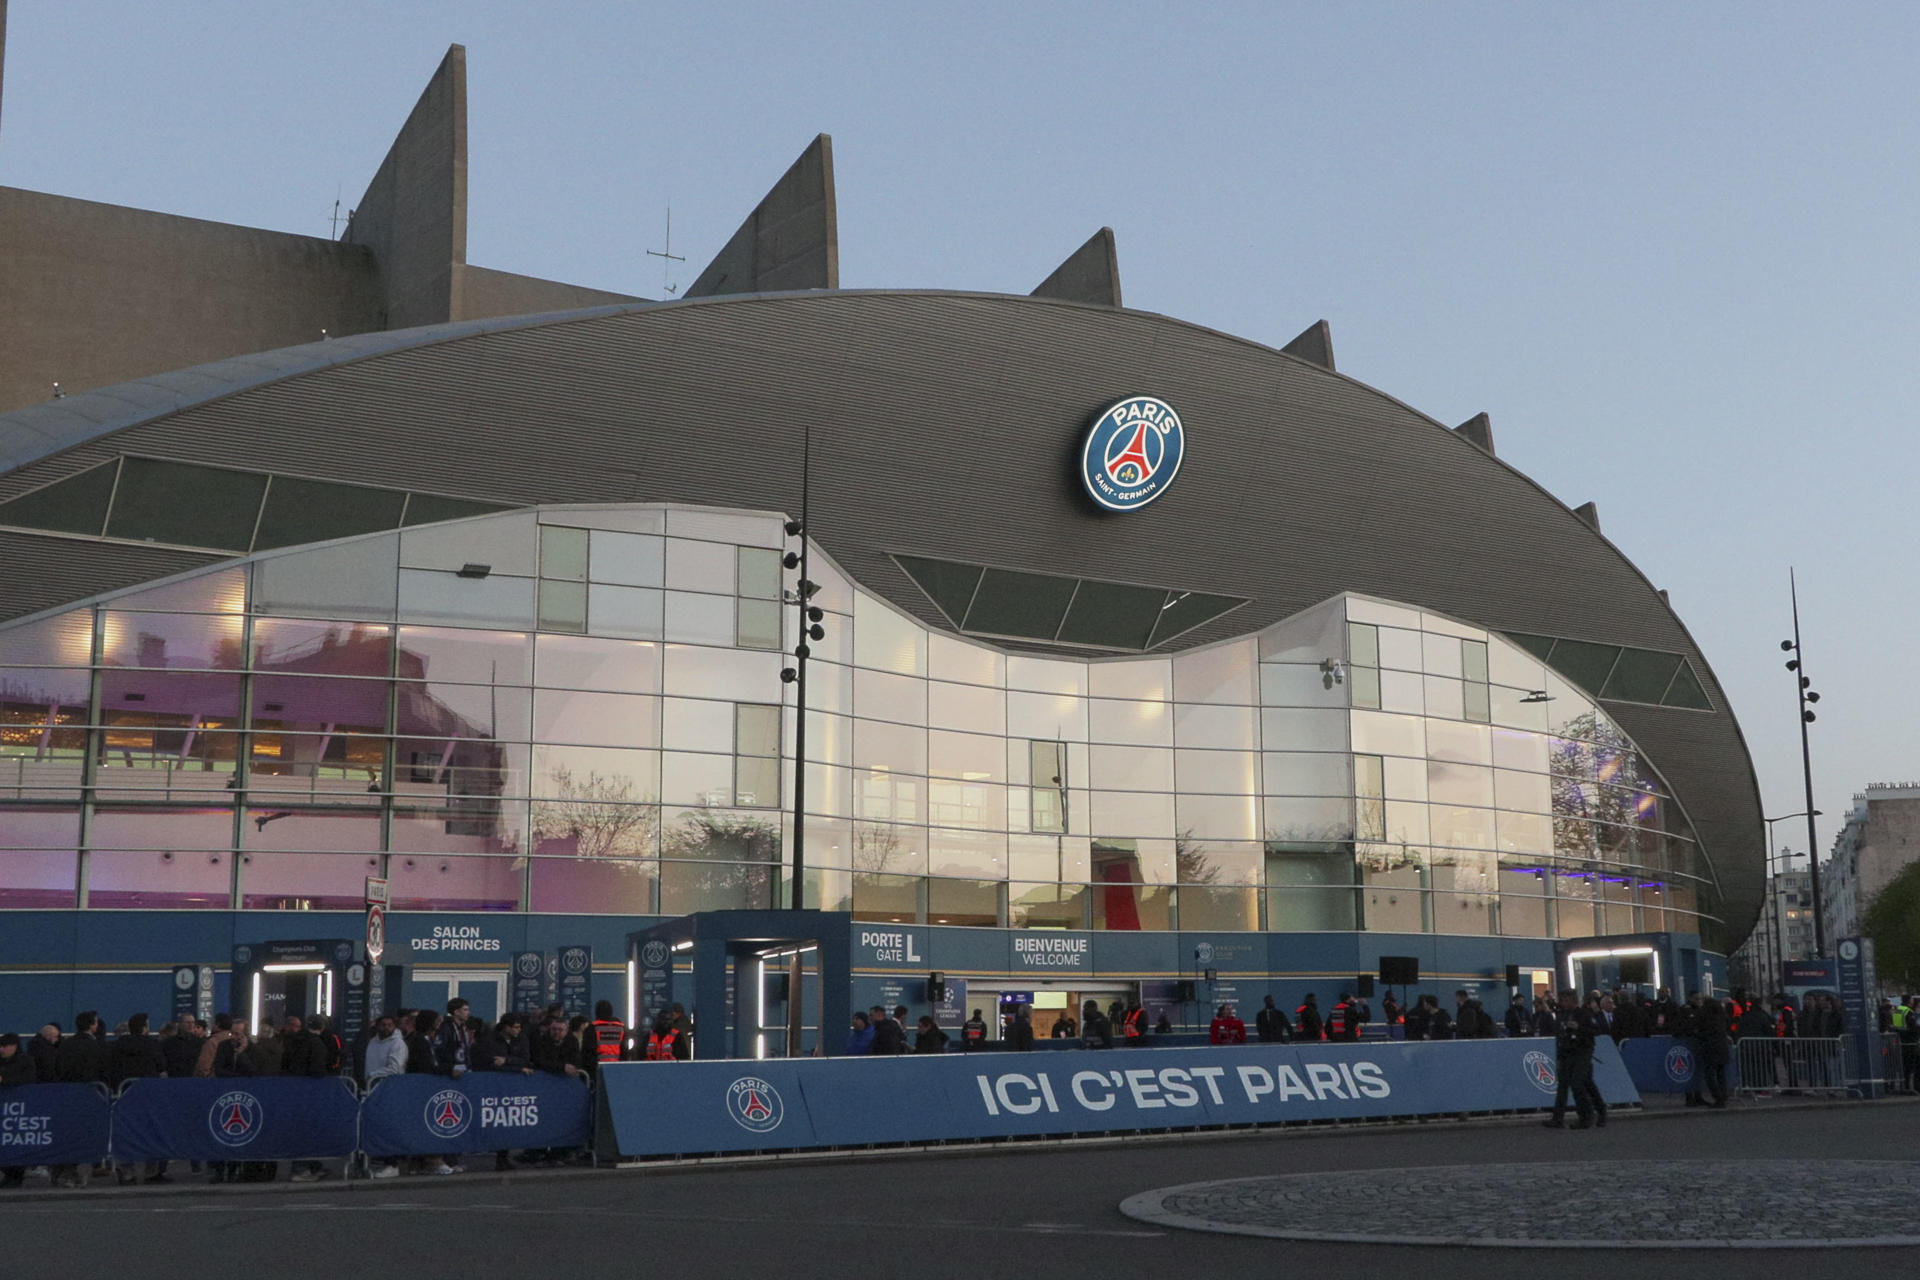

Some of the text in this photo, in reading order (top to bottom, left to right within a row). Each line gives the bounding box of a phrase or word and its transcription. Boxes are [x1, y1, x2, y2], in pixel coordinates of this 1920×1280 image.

[1112, 403, 1175, 434] PARIS
[1095, 473, 1156, 499] SAINT GERMAIN
[433, 926, 480, 938] SALON
[412, 939, 500, 951] DES PRINCES
[862, 932, 902, 947] PORTE
[1015, 938, 1087, 952] BIENVENUE
[907, 934, 921, 962] L
[876, 949, 902, 961] GATE
[1023, 954, 1080, 965] WELCOME
[181, 973, 189, 984] L
[353, 970, 360, 981] L
[733, 1080, 769, 1093] PARIS
[976, 1062, 1391, 1116] ICI C'EST PARIS
[219, 1094, 254, 1108] PARIS
[433, 1092, 463, 1104] PARIS
[481, 1096, 537, 1106] ICI C'EST
[3, 1102, 25, 1116] ICI
[481, 1106, 538, 1128] PARIS
[2, 1117, 51, 1131] C'EST
[1, 1132, 52, 1145] PARIS
